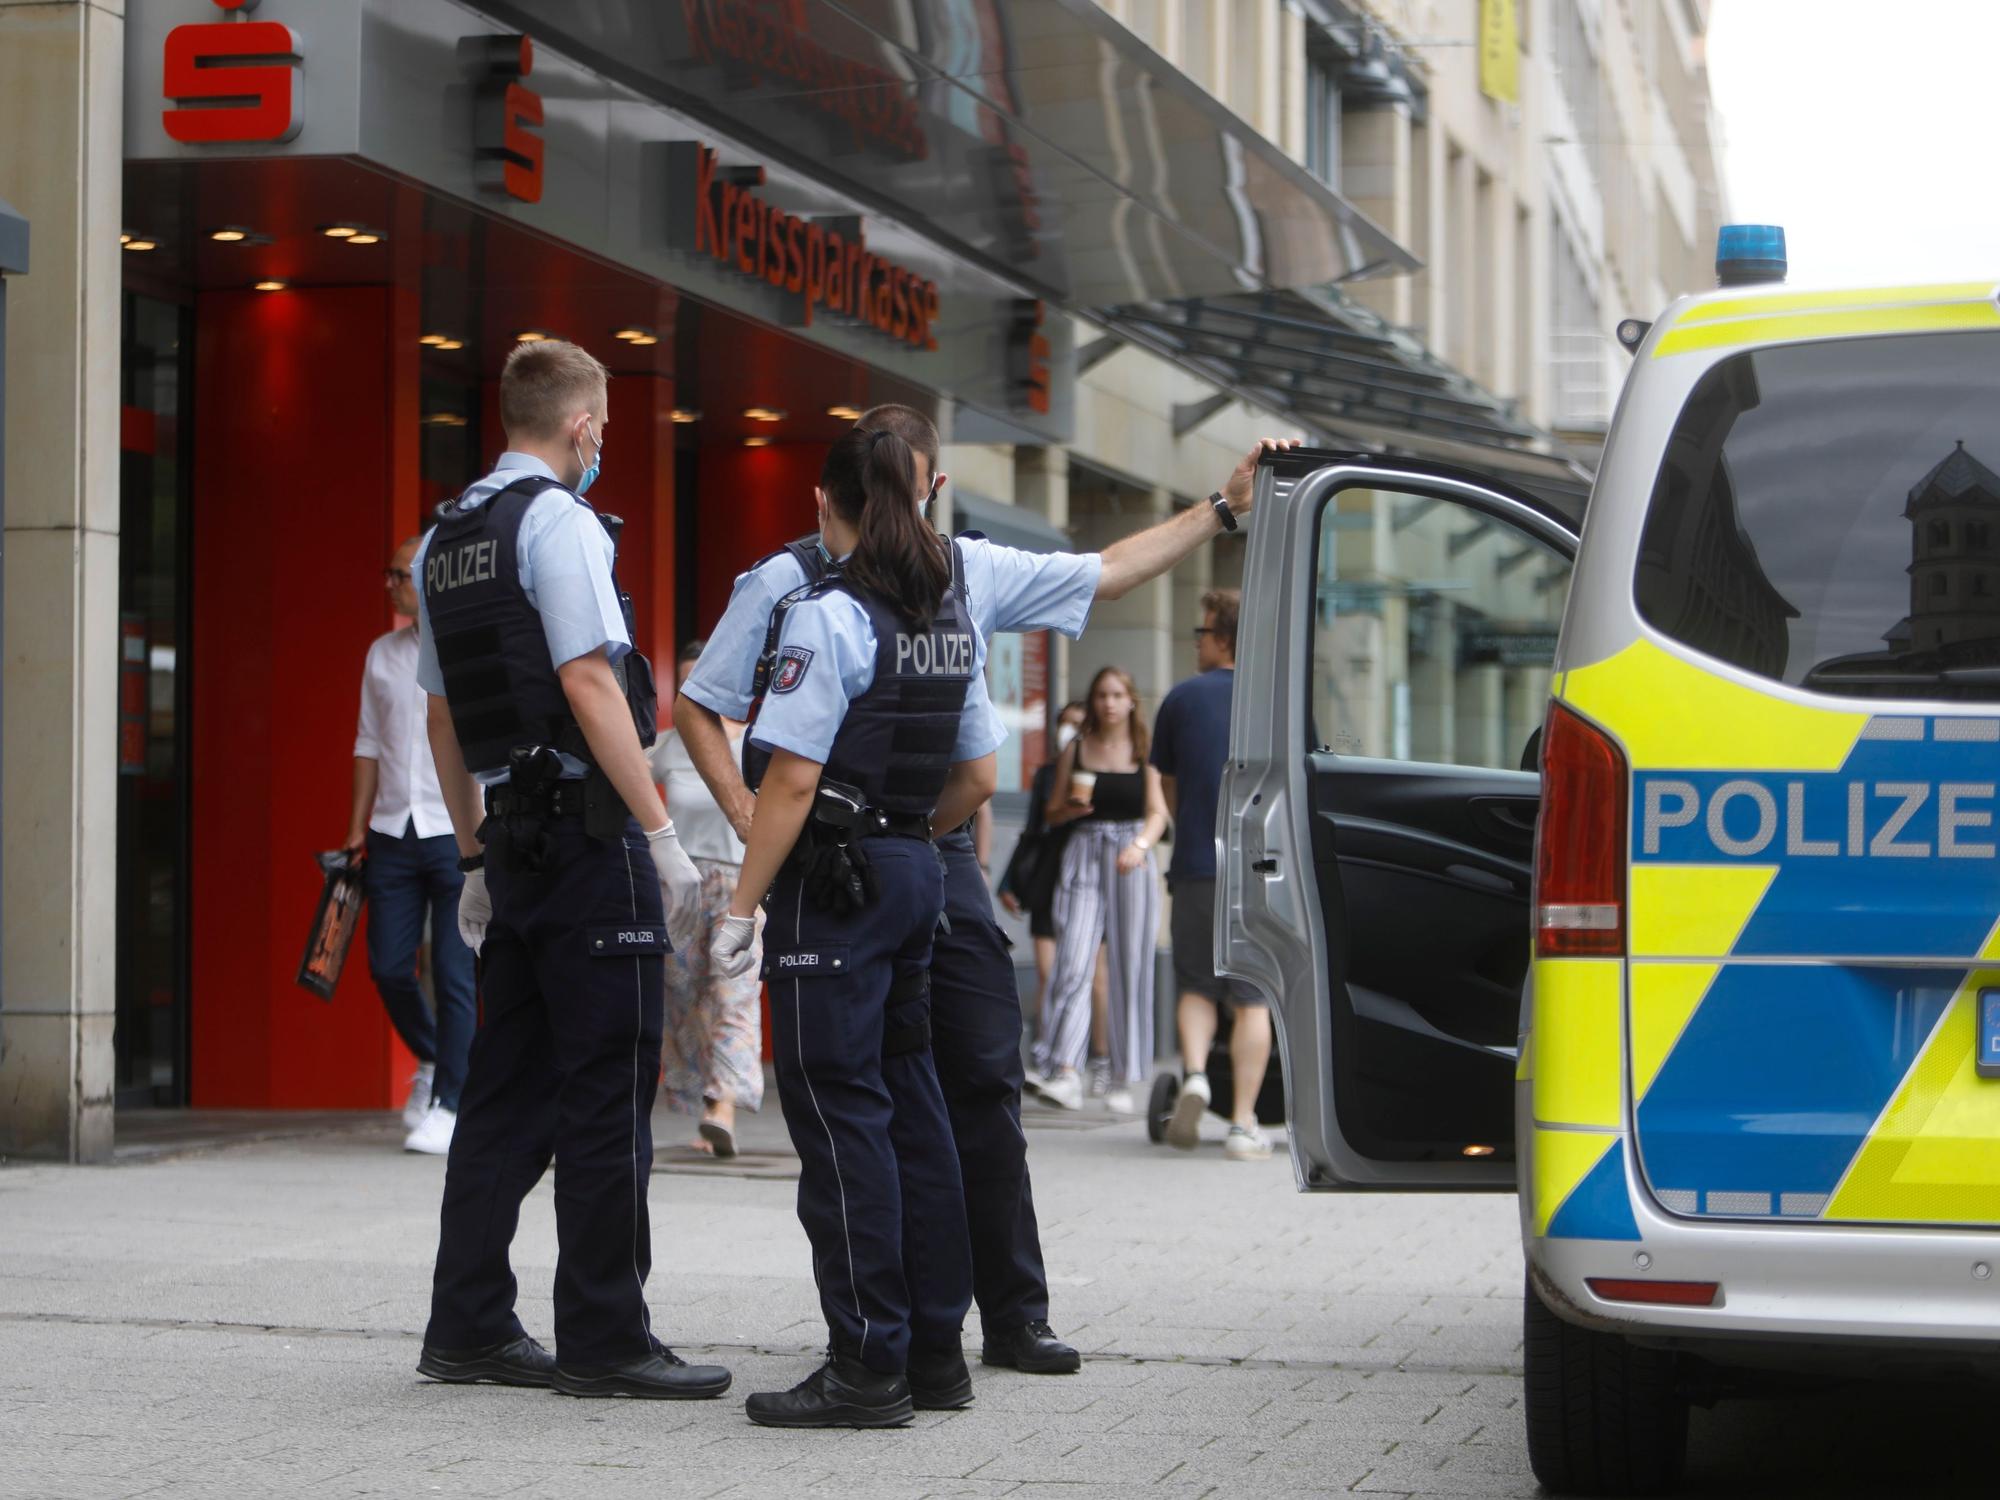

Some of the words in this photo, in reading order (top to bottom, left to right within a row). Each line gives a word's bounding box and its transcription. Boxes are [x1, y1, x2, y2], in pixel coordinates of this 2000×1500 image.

[162, 21, 293, 143] S
[695, 142, 941, 353] Kreissparkasse
[427, 539, 498, 598] POLIZEI
[895, 632, 973, 676] POLIZEI
[617, 931, 655, 944] POLIZEI
[779, 954, 819, 968] POLIZEI
